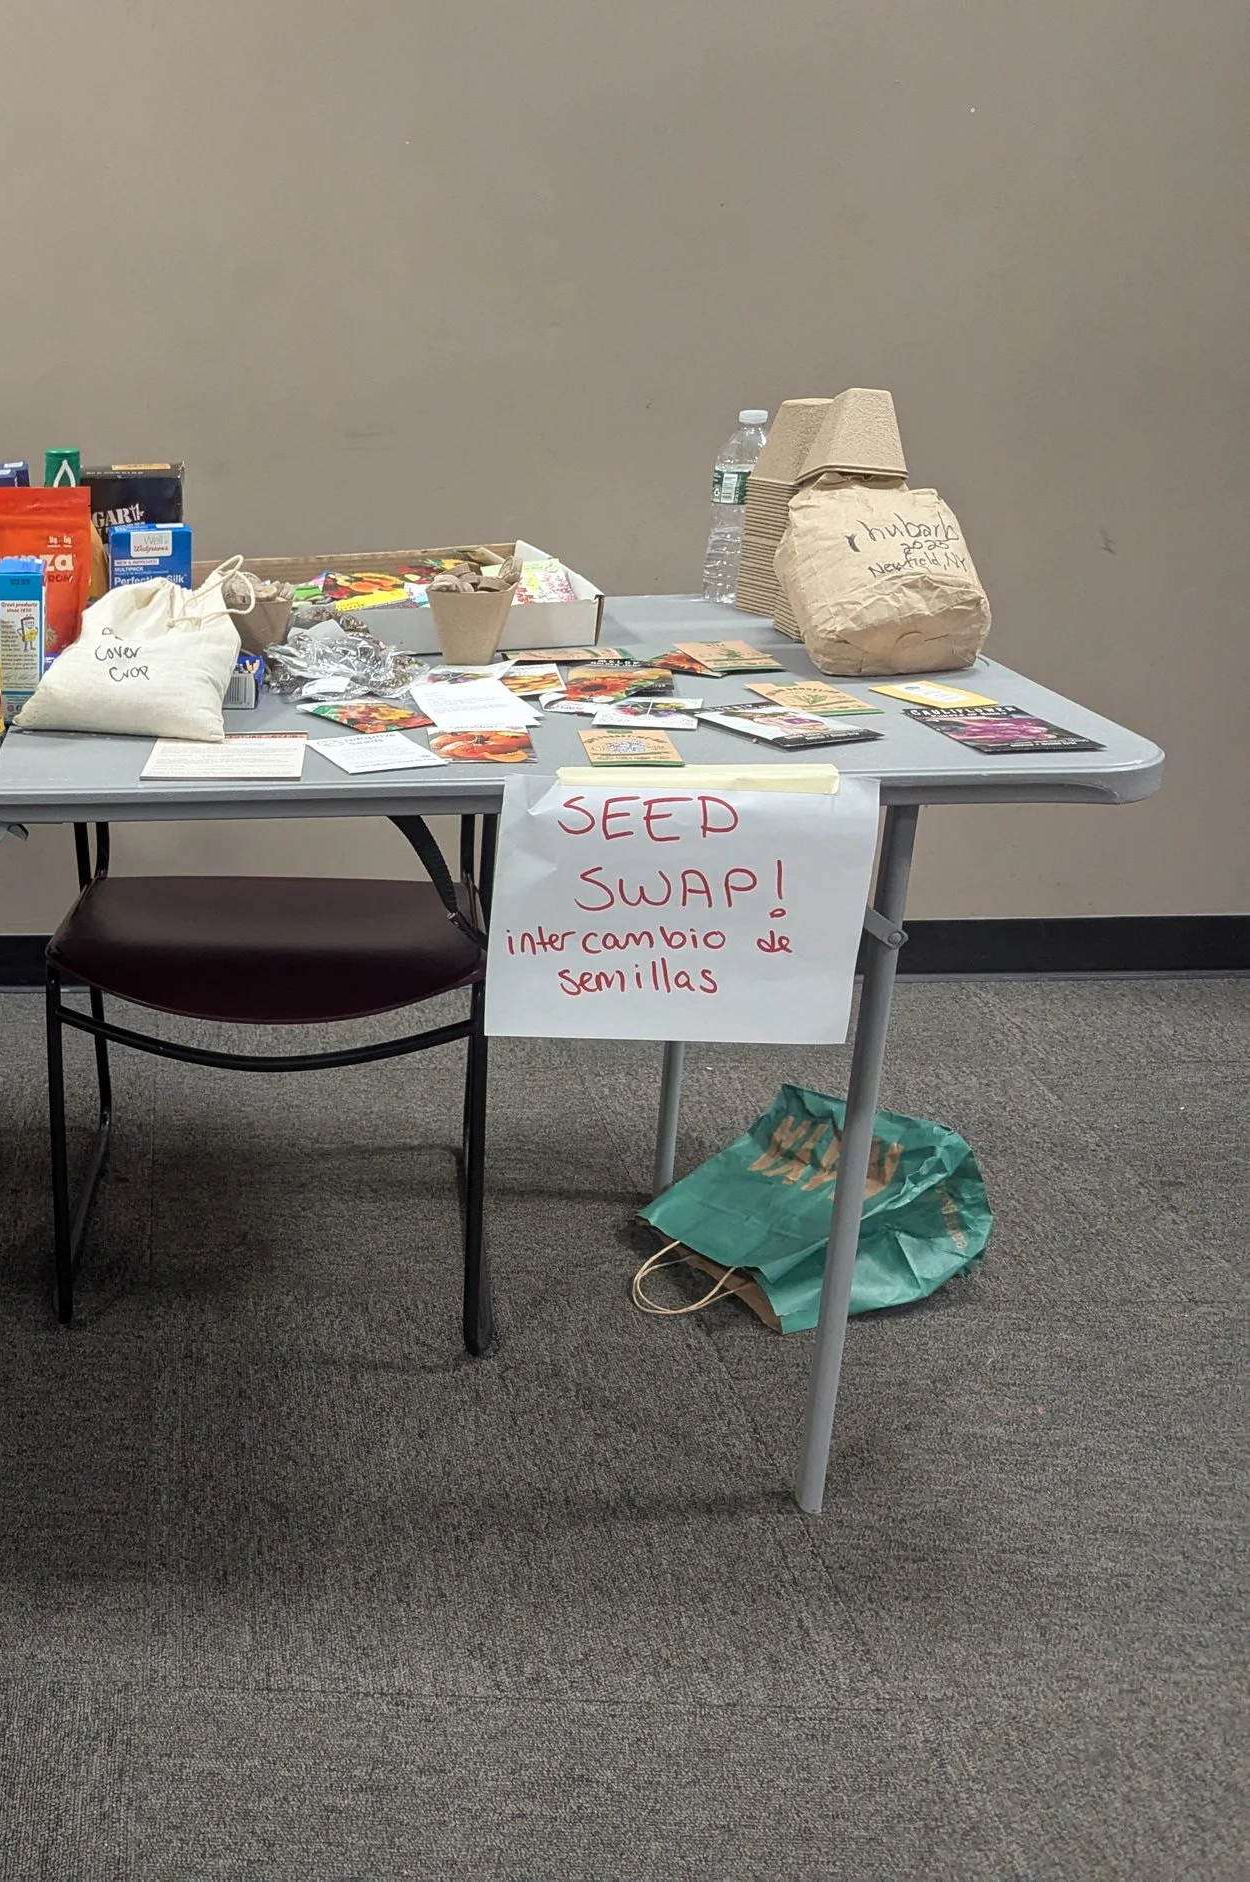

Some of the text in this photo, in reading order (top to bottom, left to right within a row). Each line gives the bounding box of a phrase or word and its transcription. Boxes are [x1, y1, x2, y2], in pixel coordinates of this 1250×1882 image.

[134, 544, 168, 554] Walgreens
[94, 645, 142, 661] Cover
[108, 665, 150, 682] Crop
[909, 706, 1017, 716] CAULIFLOWER
[556, 795, 740, 842] SEED
[574, 859, 787, 920] SWAP!
[506, 925, 794, 955] intercambio de
[557, 957, 718, 996] semillas
